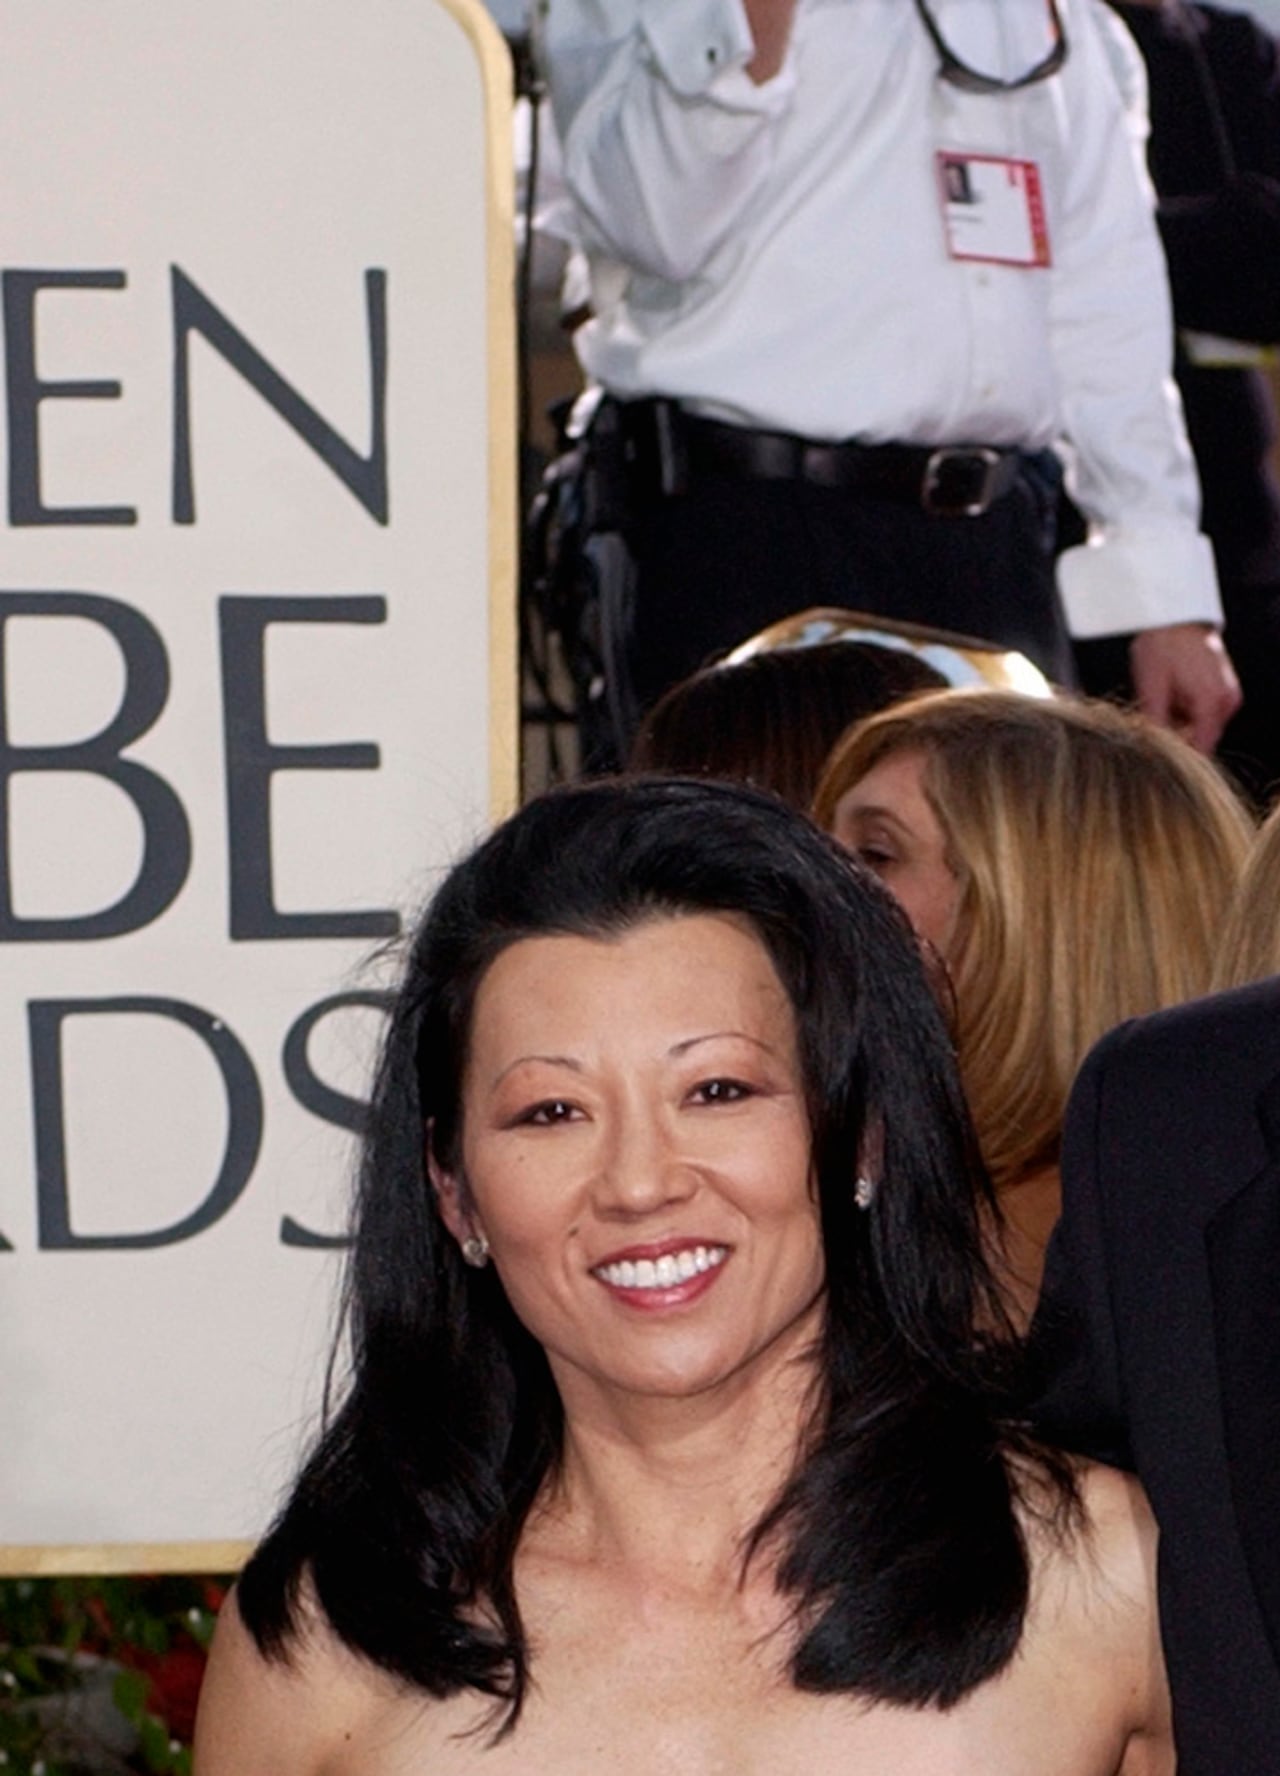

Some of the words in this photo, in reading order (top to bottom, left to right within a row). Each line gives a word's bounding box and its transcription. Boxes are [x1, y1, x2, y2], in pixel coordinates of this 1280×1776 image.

[1, 262, 389, 527] EN
[0, 590, 401, 942] BE
[0, 990, 400, 1252] DS
